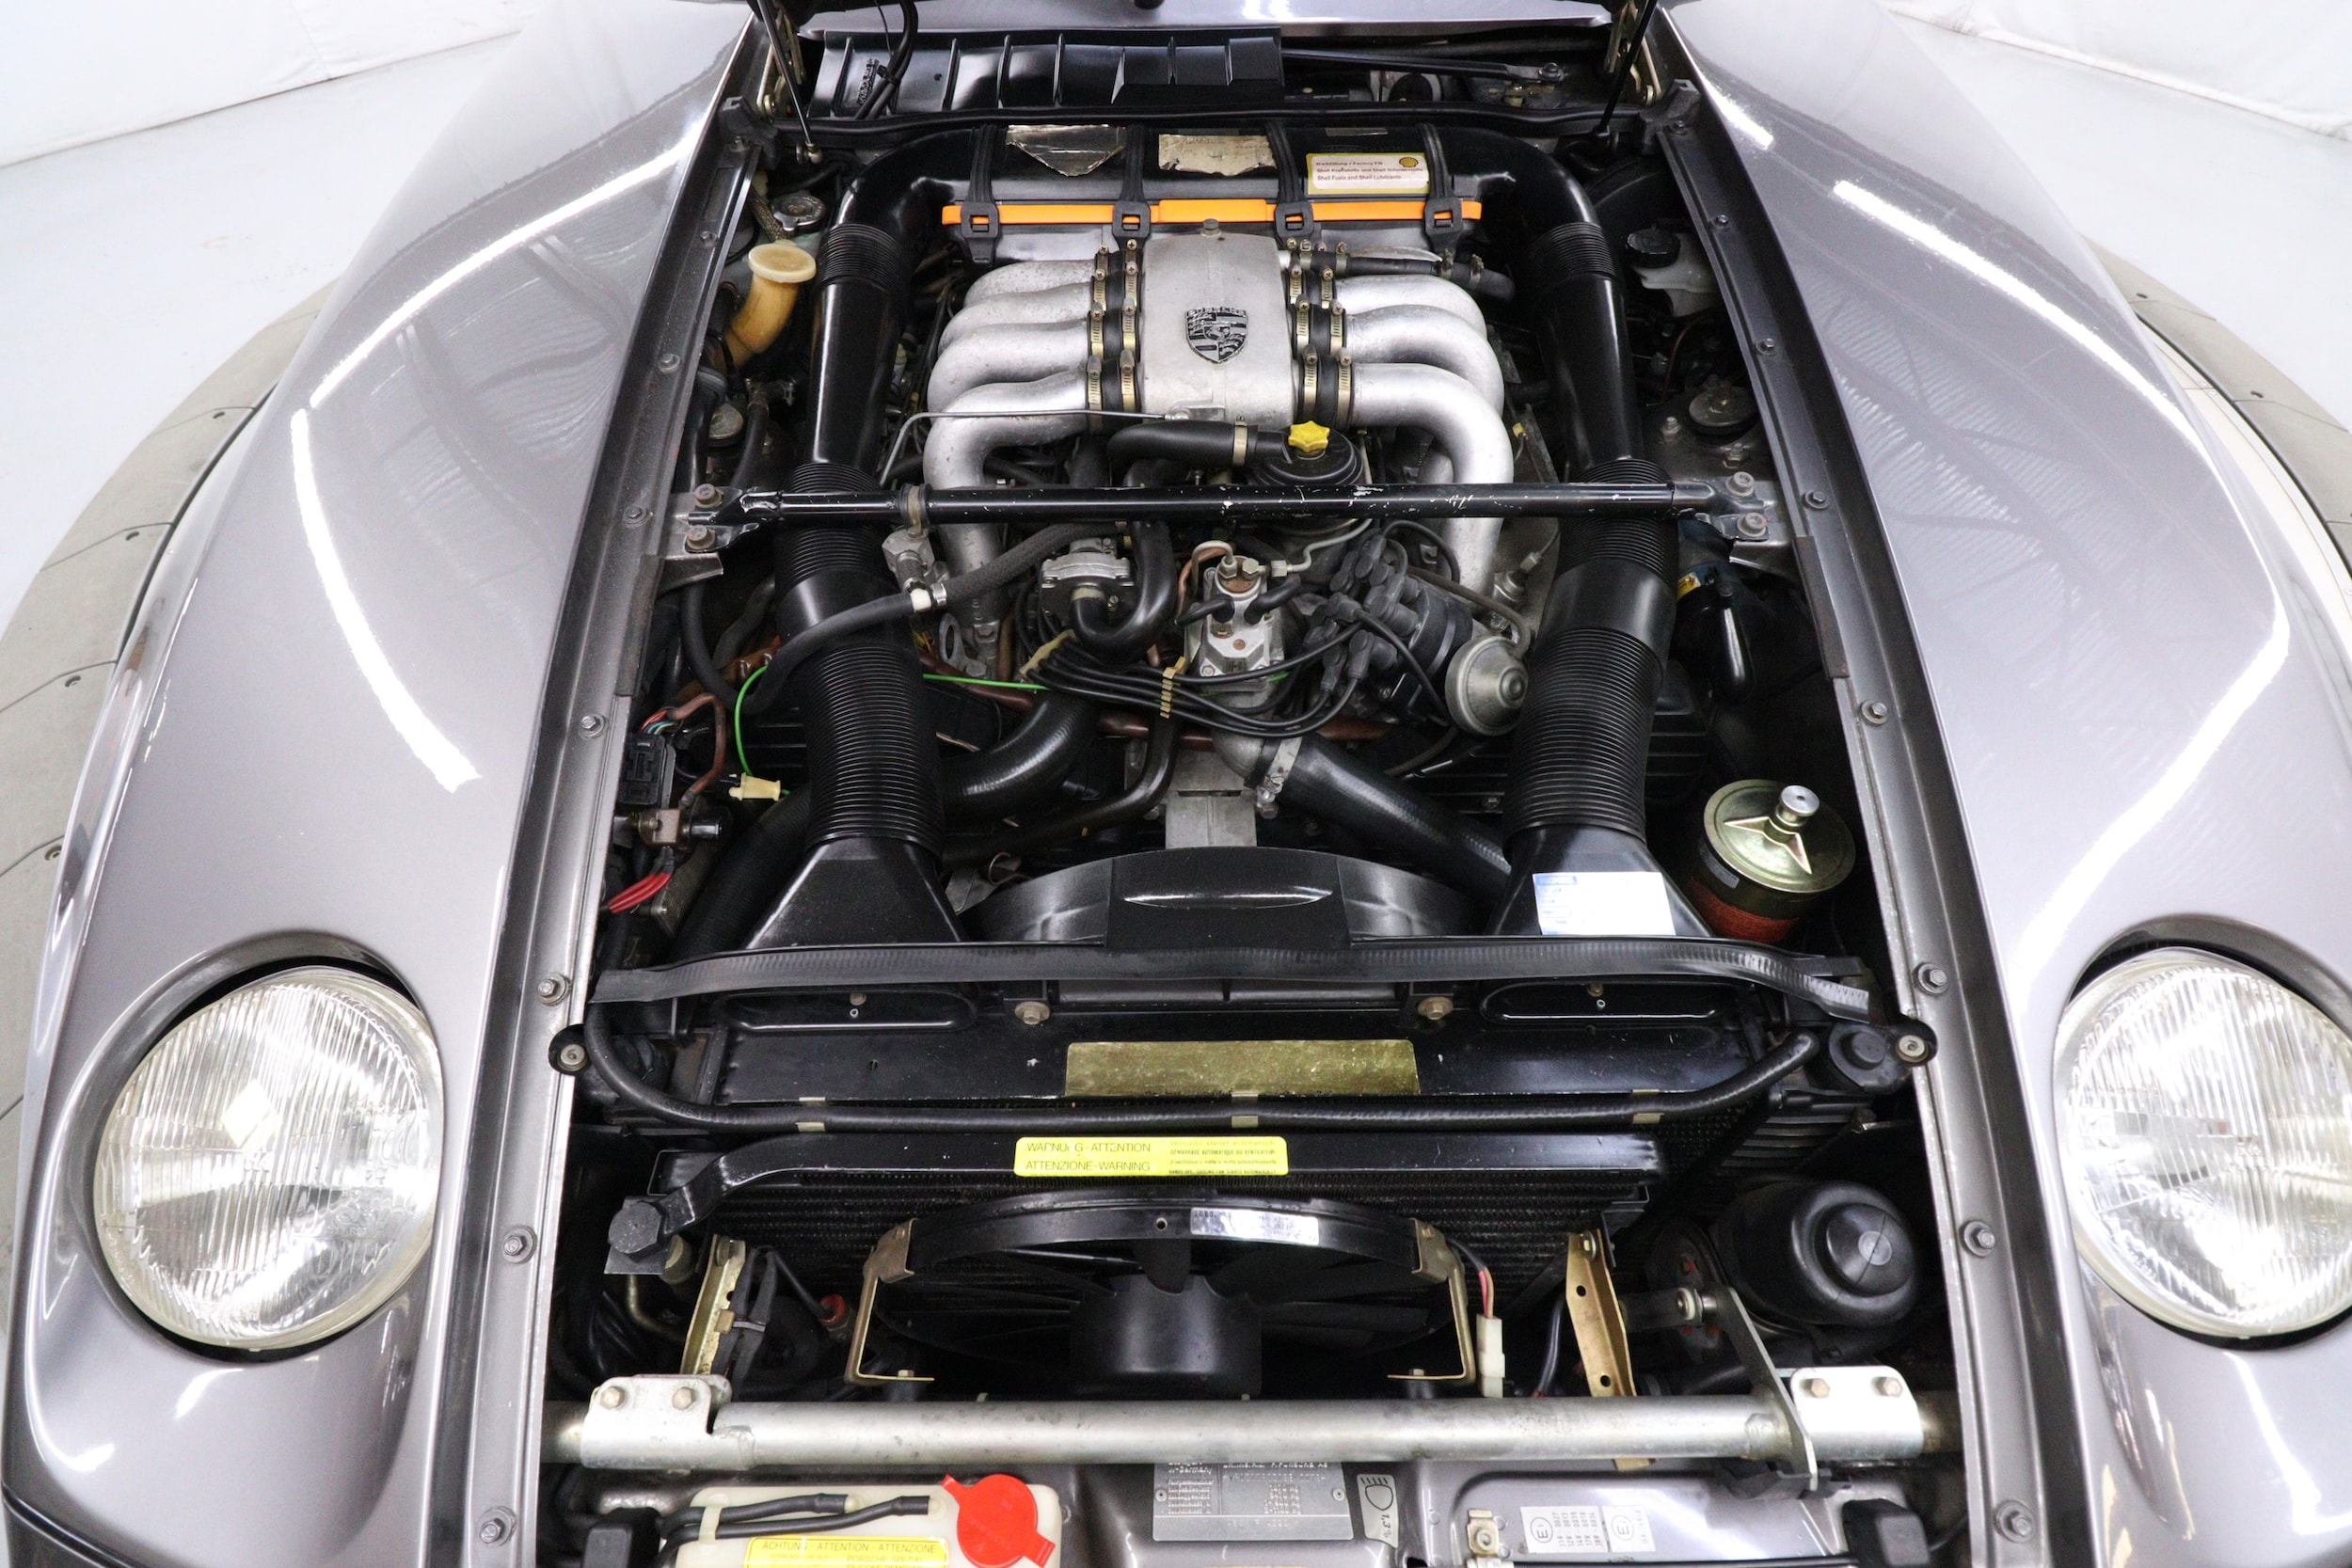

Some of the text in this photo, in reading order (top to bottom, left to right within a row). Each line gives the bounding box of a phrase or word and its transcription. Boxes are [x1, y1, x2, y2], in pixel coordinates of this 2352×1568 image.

[1090, 1143, 1152, 1152] ATTENTION
[817, 1543, 869, 1552] ATTENTION
[878, 1544, 937, 1554] ATTENZIONE
